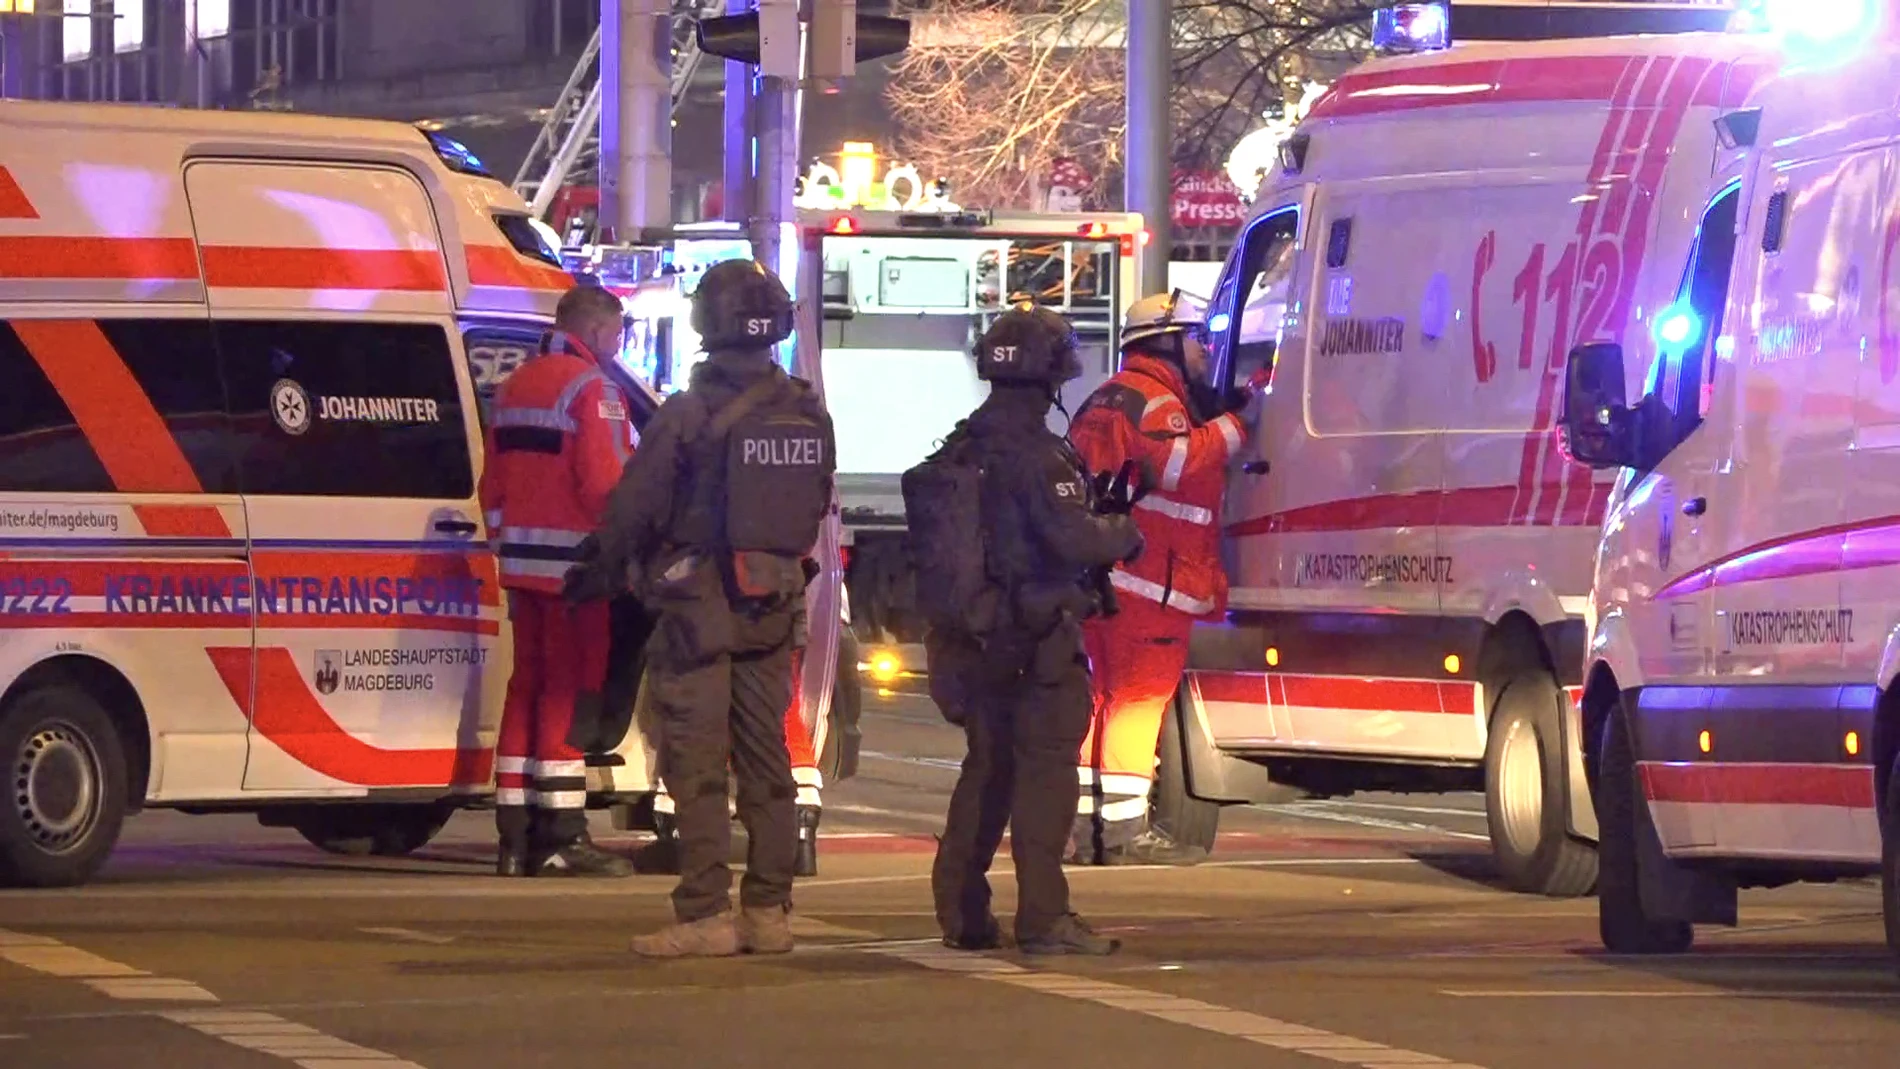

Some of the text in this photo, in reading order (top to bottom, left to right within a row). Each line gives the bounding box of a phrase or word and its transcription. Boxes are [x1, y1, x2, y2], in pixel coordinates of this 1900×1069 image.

[1174, 199, 1249, 219] Presse
[1513, 236, 1623, 370] 112
[747, 319, 772, 336] ST
[993, 346, 1017, 362] ST
[319, 396, 440, 422] JOHANNITER
[743, 438, 822, 465] POLIZEI
[1056, 482, 1077, 497] ST
[1305, 554, 1454, 583] KATASTROPHENSCHUTZ
[104, 574, 485, 616] KRANKENTRANSPORT
[1731, 609, 1854, 645] KATASTROPHENSCHUTZ
[344, 648, 489, 667] LANDESHAUPTSTADT
[344, 674, 434, 691] MAGDEBURG
